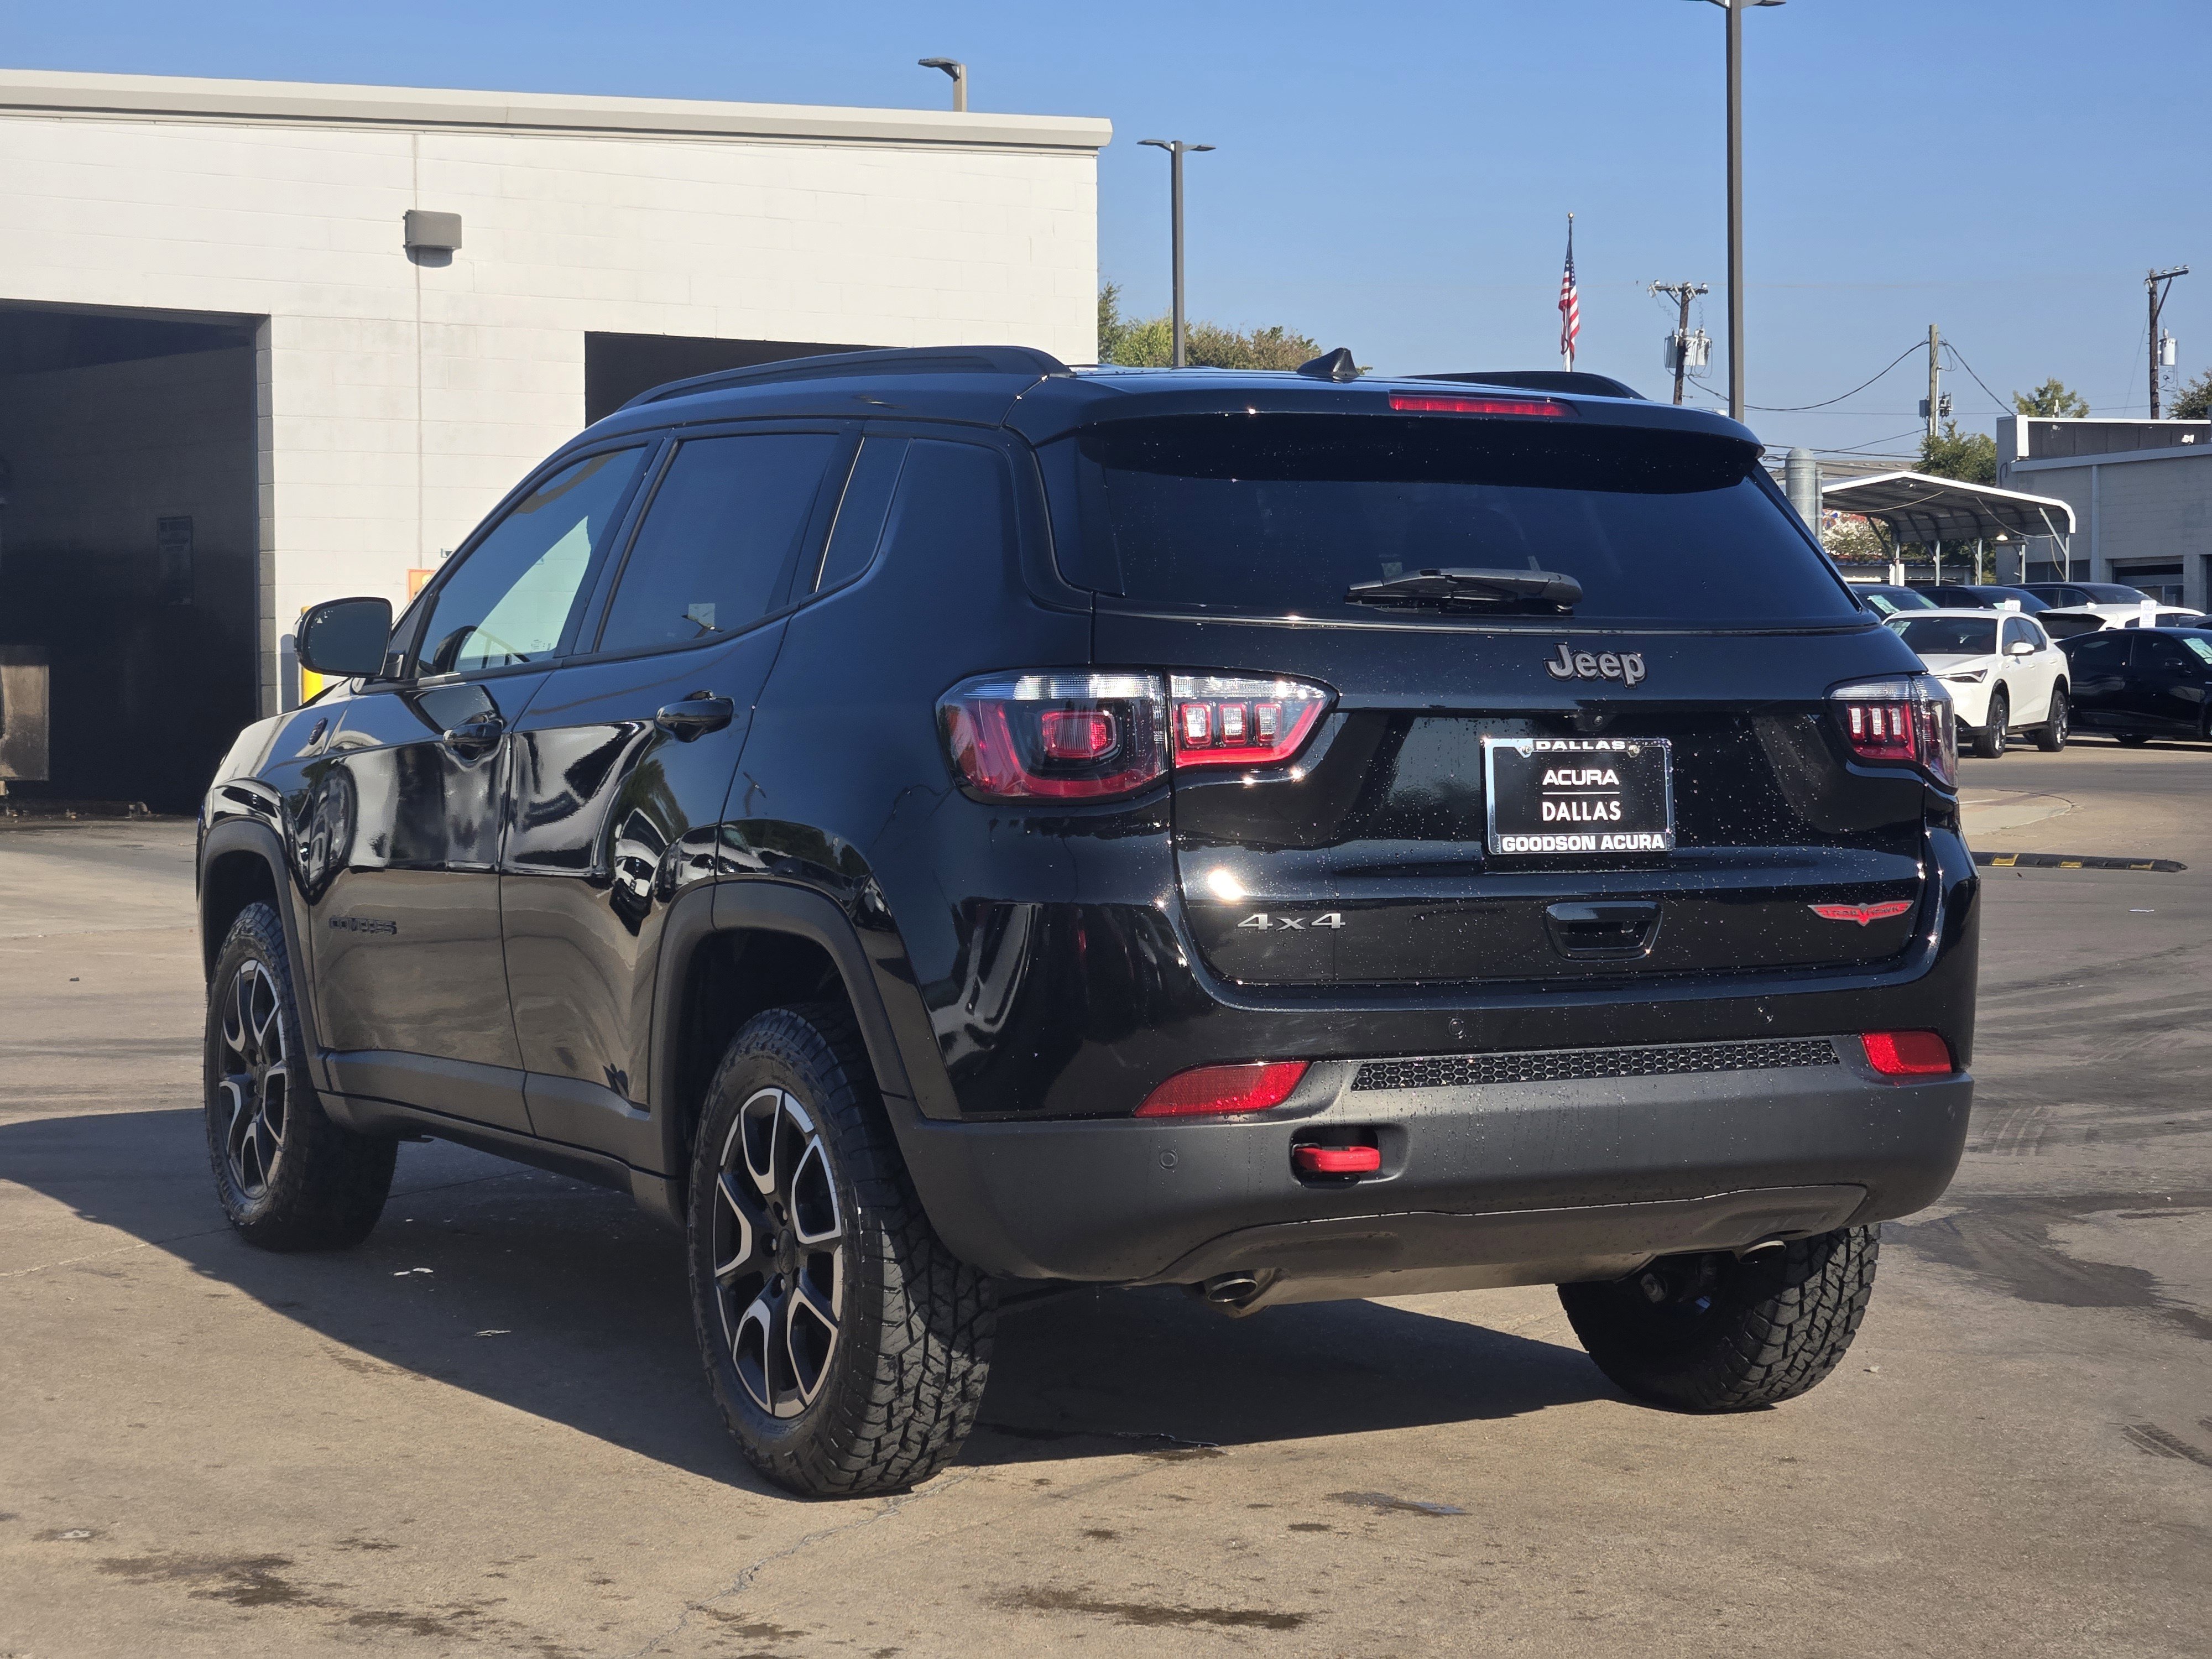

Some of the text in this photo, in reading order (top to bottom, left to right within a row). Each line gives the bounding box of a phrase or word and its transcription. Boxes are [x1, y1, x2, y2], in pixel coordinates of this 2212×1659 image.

[1545, 643, 1647, 687] Jeep
[1536, 740, 1626, 750] DALLAS
[1542, 769, 1620, 785] ACURA
[1542, 801, 1621, 821] DALLAS
[1502, 834, 1665, 852] GOODSON ACURA
